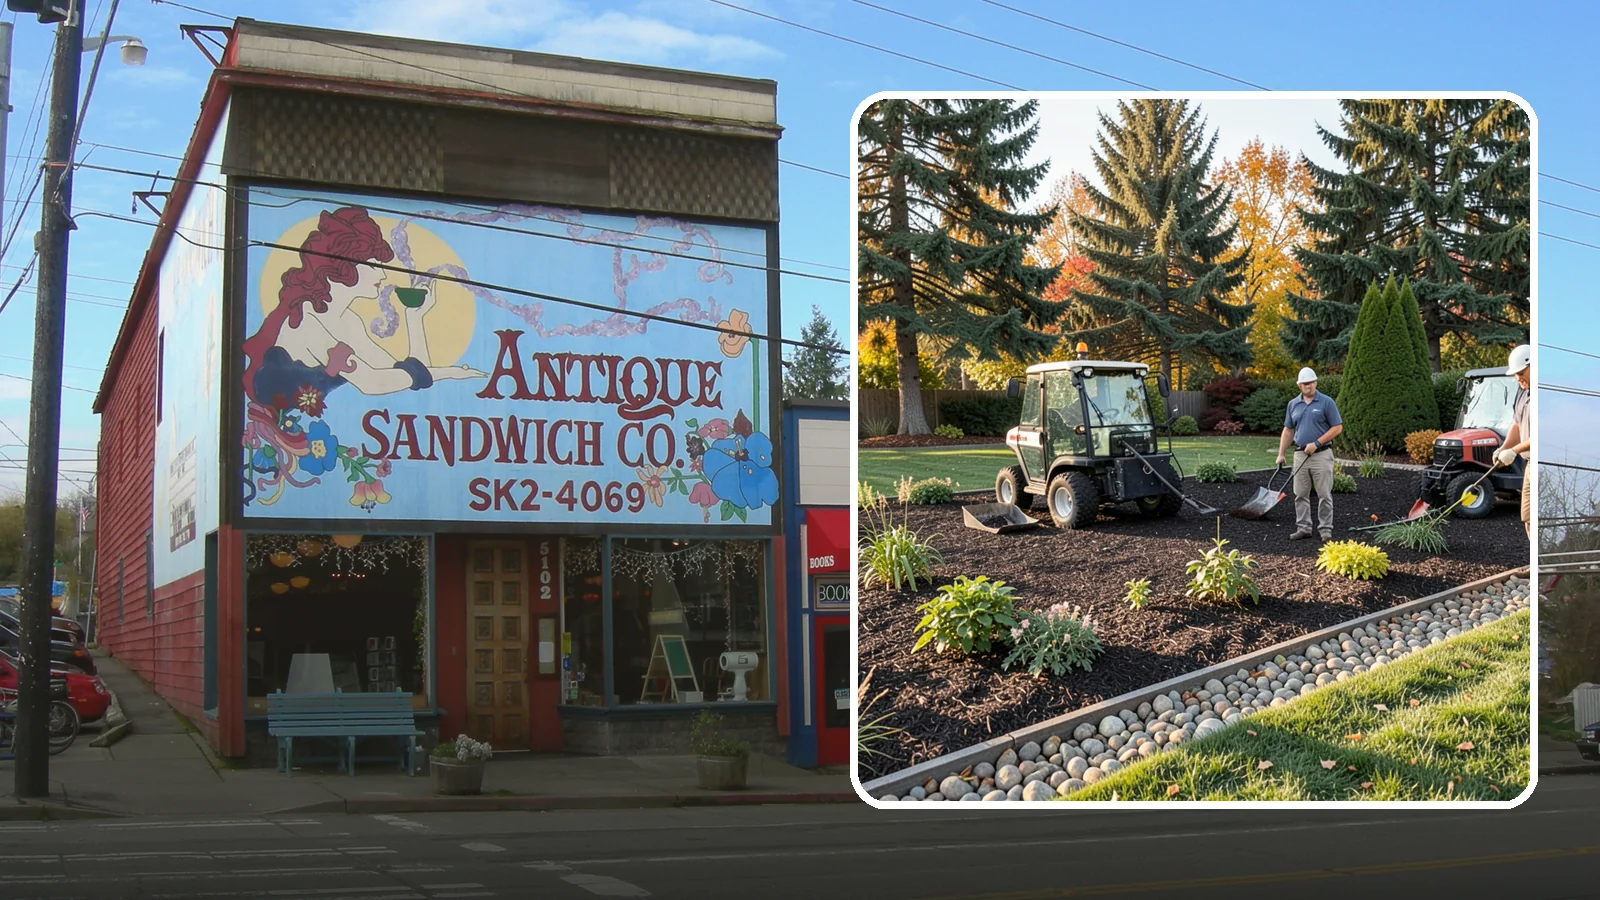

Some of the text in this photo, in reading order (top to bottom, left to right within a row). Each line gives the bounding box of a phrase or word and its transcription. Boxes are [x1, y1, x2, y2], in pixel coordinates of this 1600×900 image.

[475, 329, 724, 420] ANTIQUE
[360, 409, 685, 470] SANDWICH CO.
[469, 478, 646, 513] SK2-4069
[540, 541, 551, 600] 5102
[809, 555, 834, 569] BOOKS
